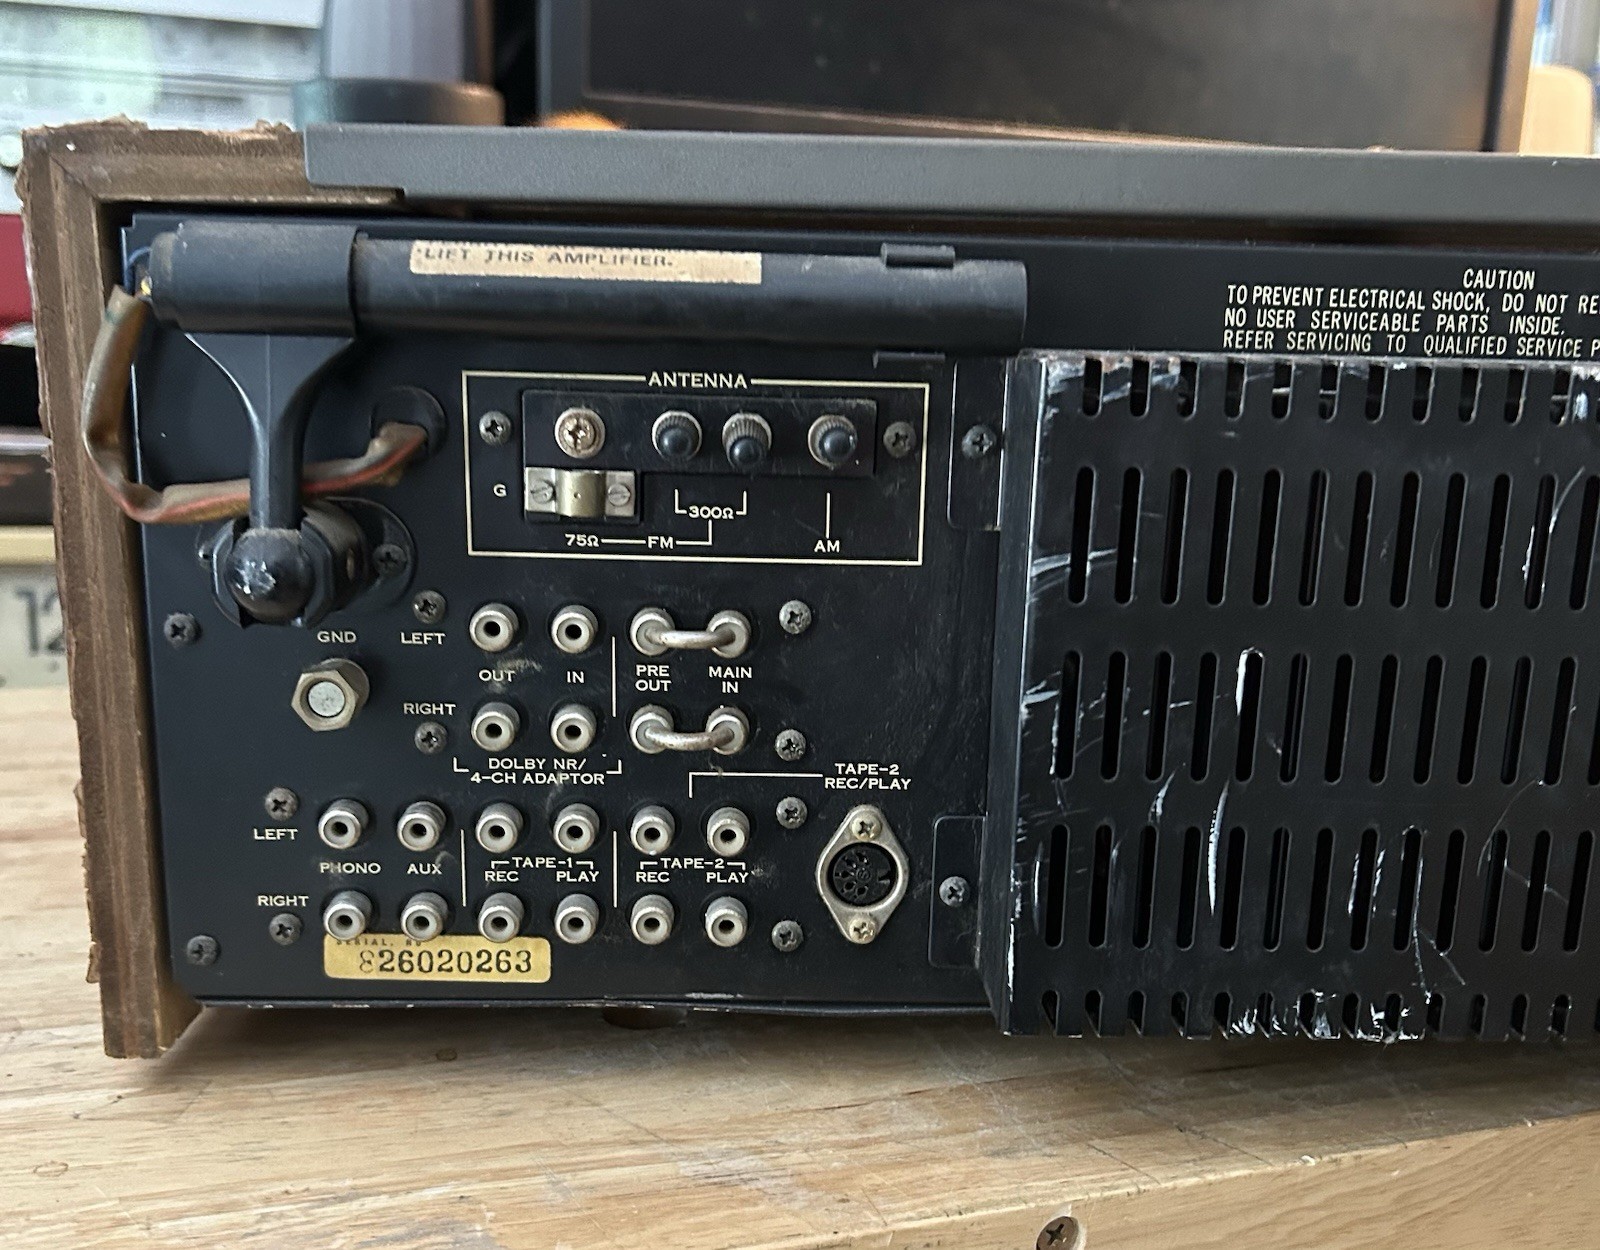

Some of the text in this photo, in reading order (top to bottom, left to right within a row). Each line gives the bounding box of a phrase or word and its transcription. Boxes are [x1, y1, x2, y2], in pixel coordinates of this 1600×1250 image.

[1463, 268, 1535, 290] CAUTION
[1227, 285, 1600, 314] TO PREVENT ELECTRICAL SHOCK, DO NOT RE
[1224, 308, 1565, 336] NO USER SERVICEABLE PARTS INSIDE.
[1223, 329, 1274, 350] REFER
[1286, 332, 1372, 352] SERVICING
[1386, 334, 1406, 353] TO
[1423, 335, 1507, 356] QUALIFIED
[1517, 337, 1583, 358] SERVICE
[648, 372, 747, 389] ANTENNA
[493, 484, 507, 497] G
[688, 506, 734, 520] 300Ω
[565, 534, 599, 548] 75Ω
[648, 536, 674, 549] FM
[814, 540, 840, 553] AM
[317, 631, 357, 643] GND
[401, 632, 446, 645] LEFT
[478, 670, 516, 682] OUT
[567, 671, 585, 683] IN
[636, 665, 670, 677] PRE
[709, 666, 752, 678] MAIN
[635, 680, 672, 692] OUT
[722, 681, 739, 693] IN
[403, 703, 457, 715] RIGHT
[488, 758, 587, 770] DOLBY NR/
[835, 763, 900, 775] TAPE-2
[470, 773, 605, 785] 4-CH ADAPTOR
[825, 777, 911, 790] REC/PLAY
[253, 828, 298, 840] LEFT
[320, 862, 381, 874] PHONO
[407, 863, 442, 875] AUX
[512, 857, 573, 869] TAPE-1
[660, 858, 725, 869] TAPE-2
[484, 871, 519, 882] REC
[556, 871, 599, 883] PLAY
[636, 872, 670, 883] REC
[706, 872, 749, 883] PLAY
[258, 895, 309, 907] RIGHT
[359, 949, 532, 974] 826020263
